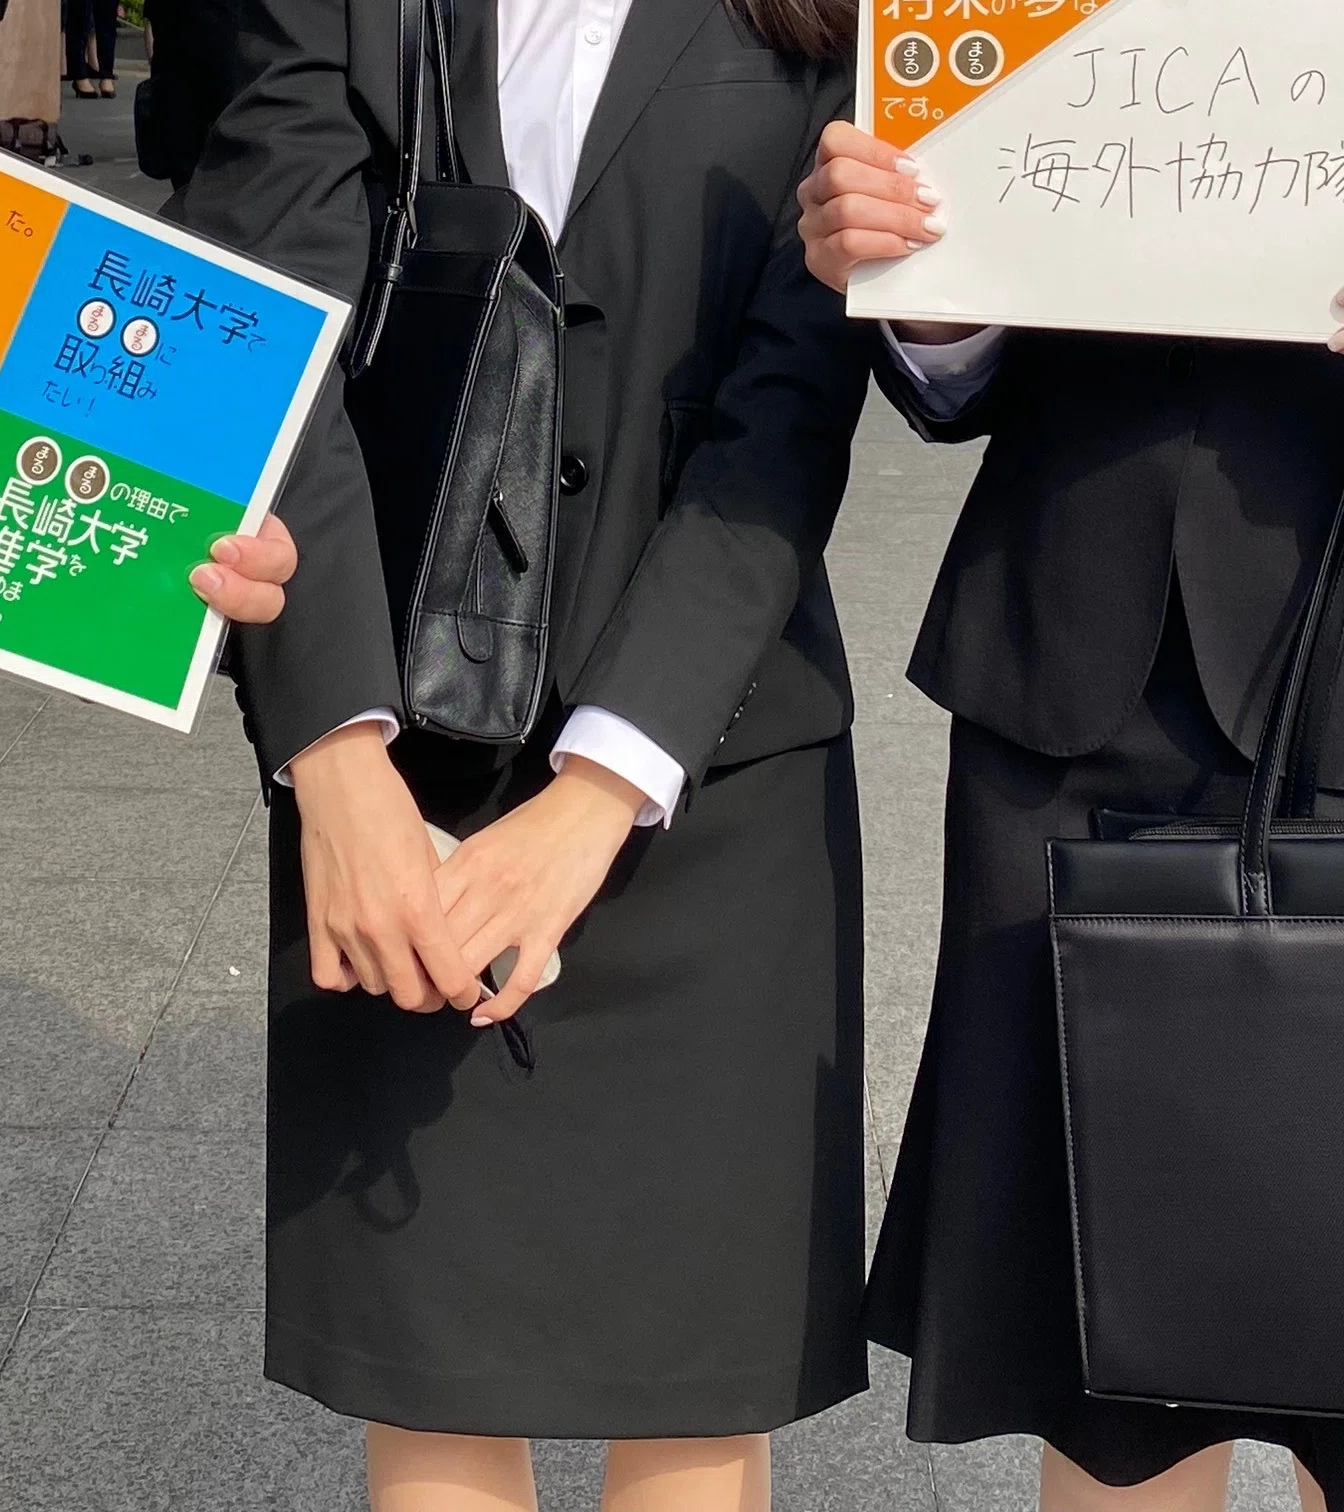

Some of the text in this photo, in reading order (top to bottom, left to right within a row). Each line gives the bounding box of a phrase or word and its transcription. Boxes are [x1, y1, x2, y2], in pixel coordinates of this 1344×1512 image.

[903, 40, 985, 76] まる まる
[881, 95, 946, 122] です。
[87, 249, 268, 353] 長崎大学で
[53, 333, 157, 400] 取り組み
